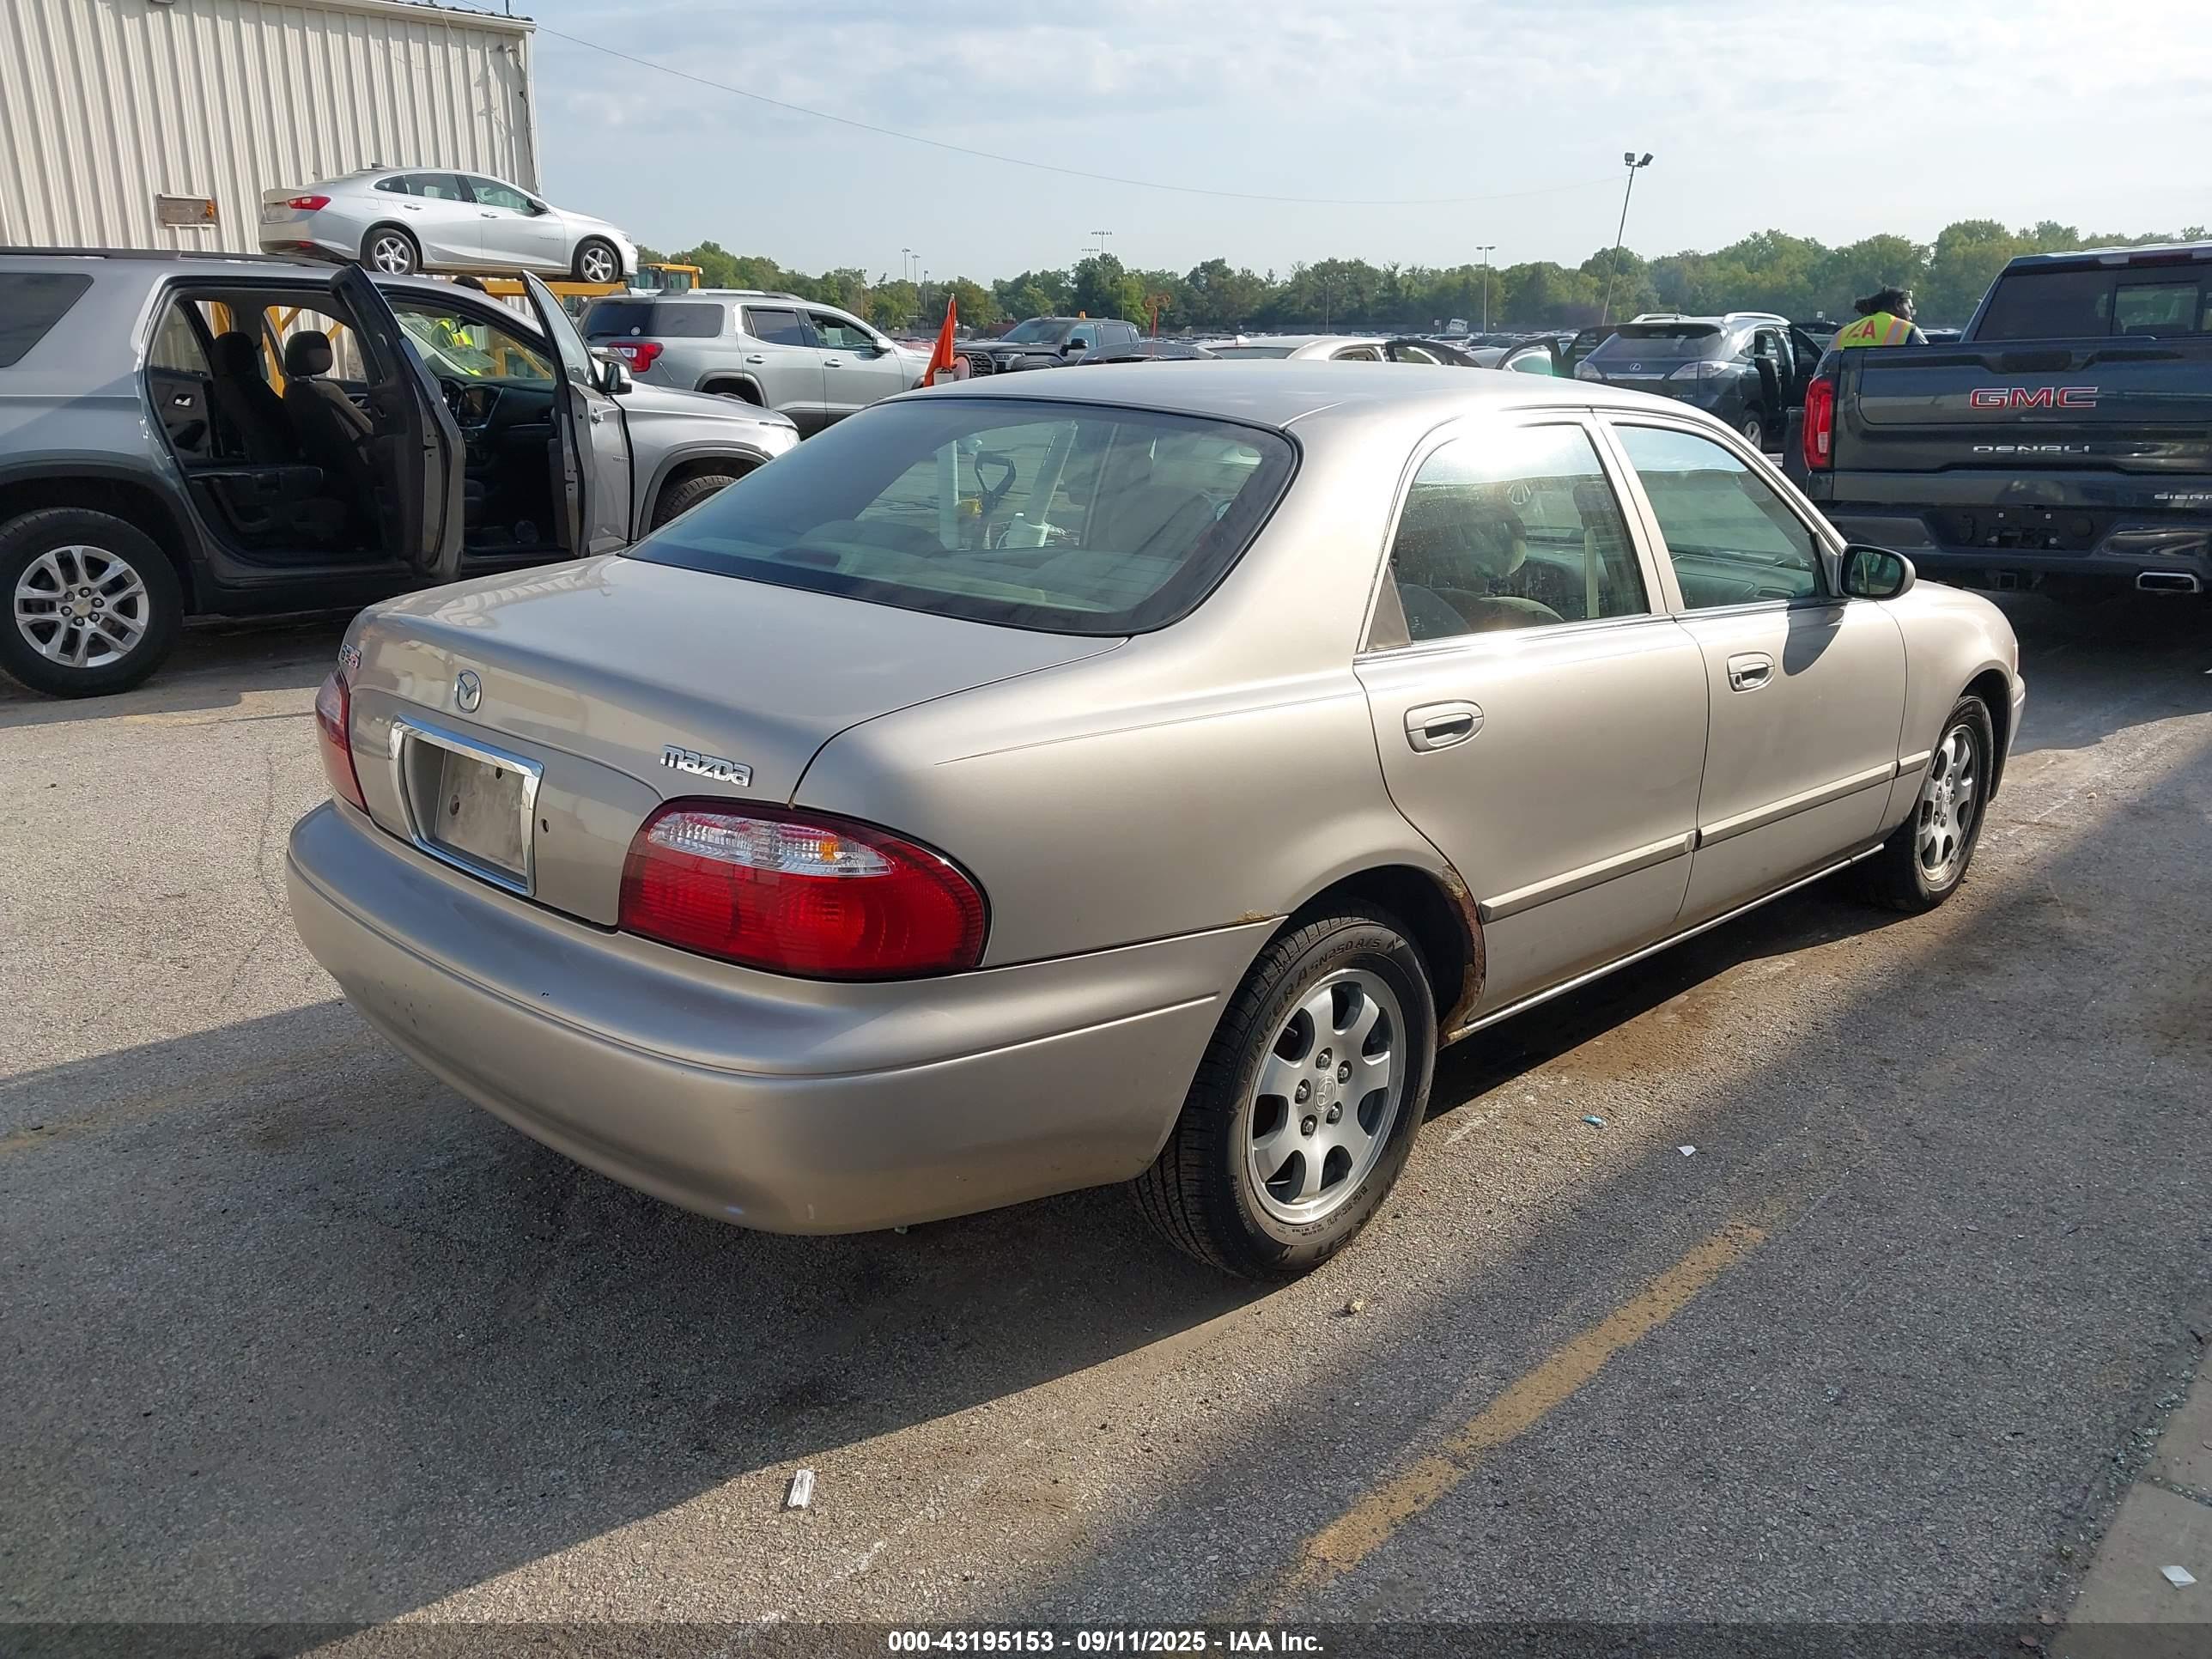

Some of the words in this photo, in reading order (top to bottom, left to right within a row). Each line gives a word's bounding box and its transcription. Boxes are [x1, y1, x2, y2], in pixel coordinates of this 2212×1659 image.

[1970, 386, 2099, 409] GMC
[1972, 444, 2090, 454] DENALI
[1310, 939, 1354, 971] SN250
[1353, 936, 1382, 951] A/S
